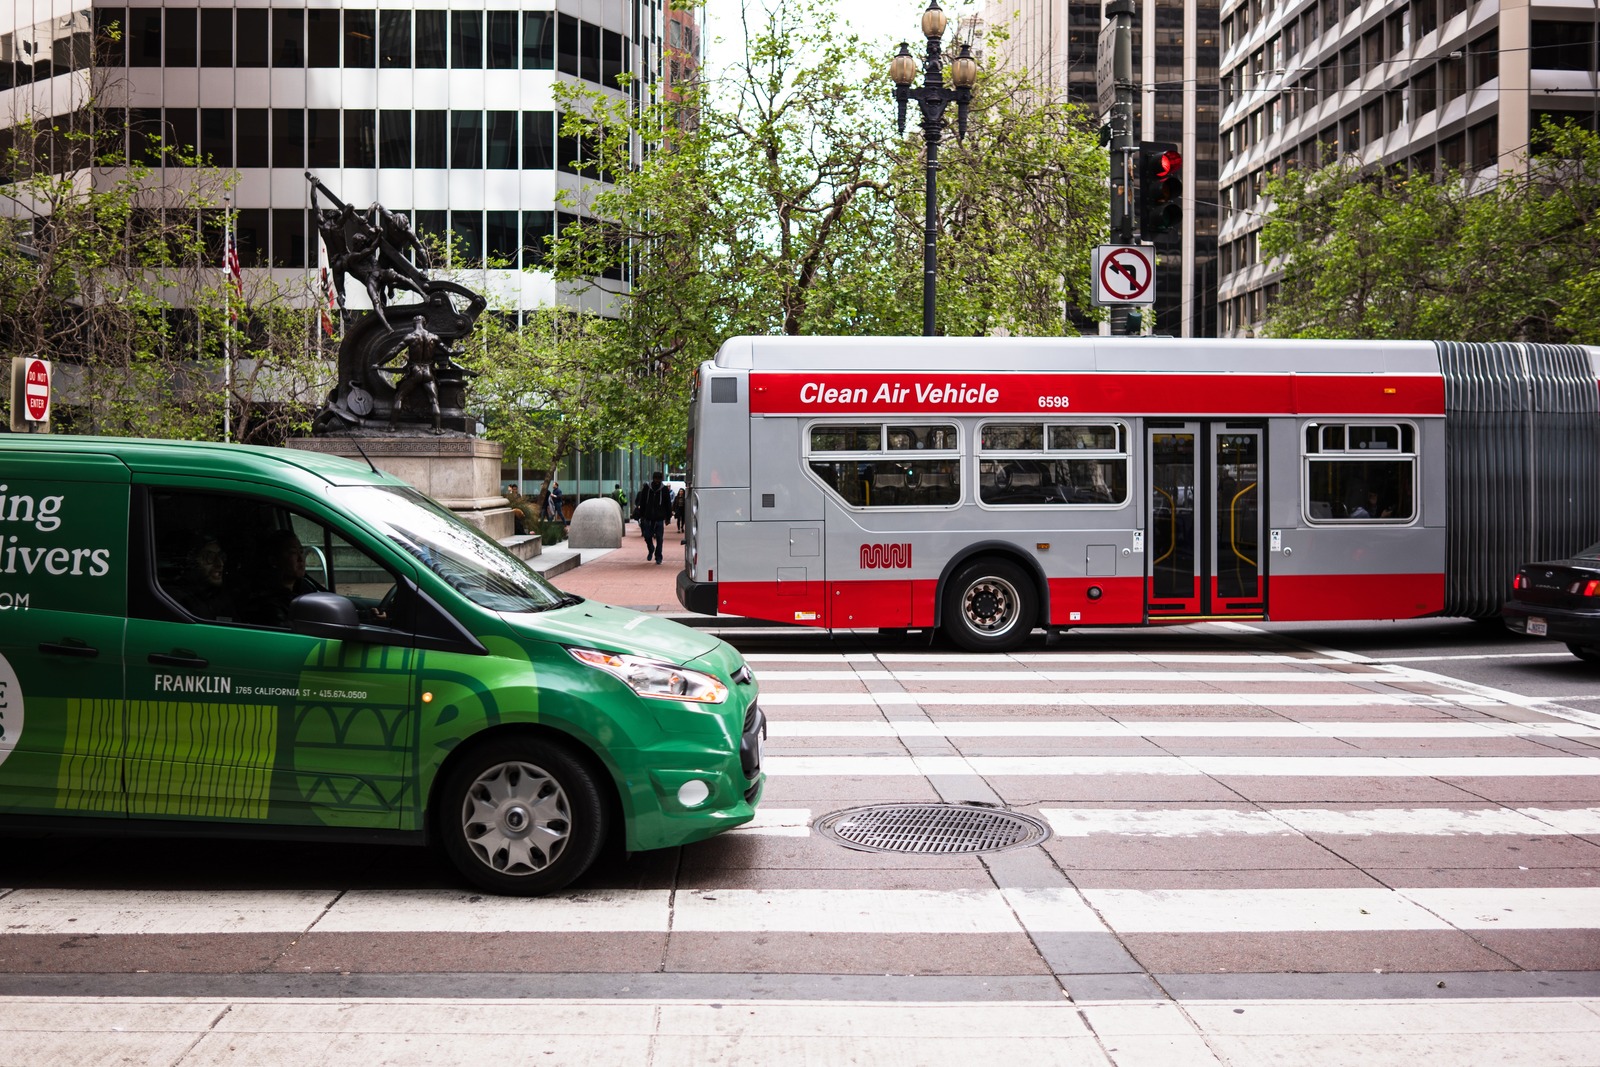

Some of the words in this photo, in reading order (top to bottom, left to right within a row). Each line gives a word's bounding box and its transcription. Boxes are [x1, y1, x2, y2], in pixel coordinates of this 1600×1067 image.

[1098, 58, 1112, 86] BLOCK
[29, 371, 36, 381] DO
[37, 373, 47, 382] NOT
[30, 398, 45, 408] ENTER
[800, 382, 868, 403] Clean
[873, 383, 909, 403] Air
[914, 383, 999, 403] Vehicle
[1038, 396, 1069, 408] 6598
[0, 484, 64, 532] ing
[154, 674, 231, 694] FRANKLIN
[235, 686, 253, 695] 1765
[254, 687, 300, 697] CALIFORNIA
[302, 689, 311, 697] ST
[319, 690, 368, 699] 415.674.0500
